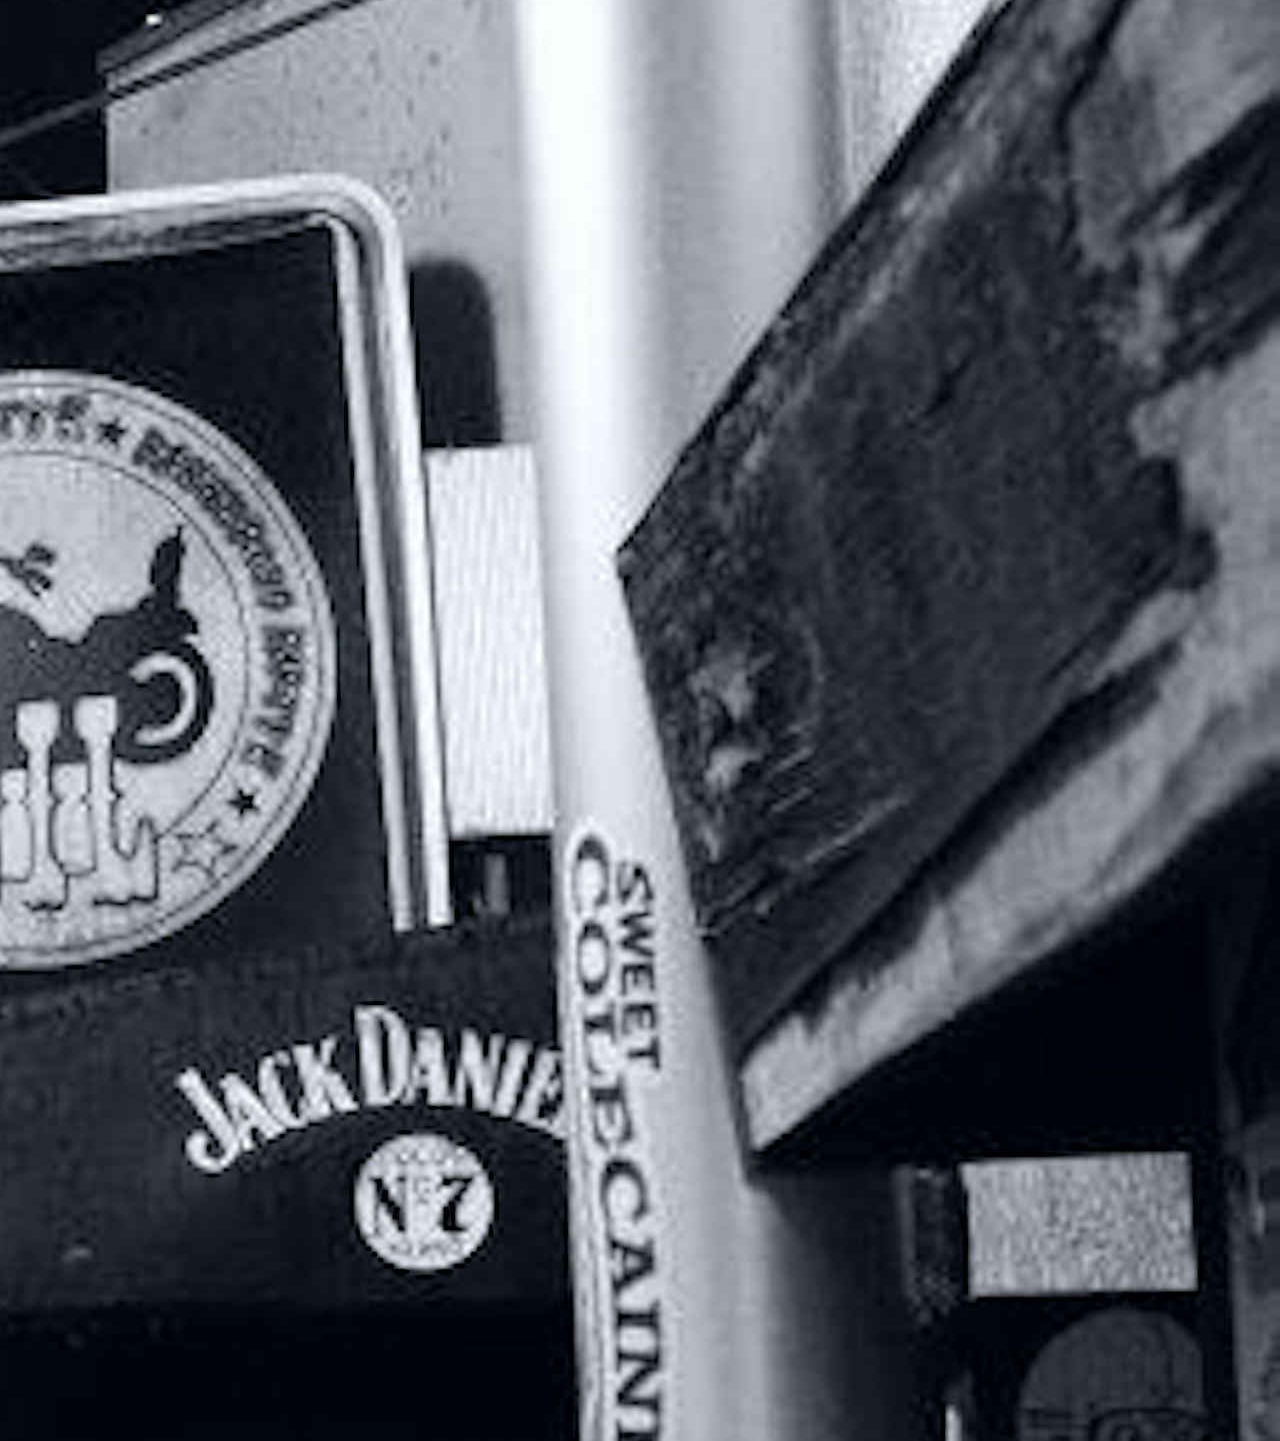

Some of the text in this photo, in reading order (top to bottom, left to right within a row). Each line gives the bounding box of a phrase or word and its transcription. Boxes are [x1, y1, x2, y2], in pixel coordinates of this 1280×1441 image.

[617, 861, 662, 1070] SWEET
[174, 1004, 566, 1173] JACK DANIE
